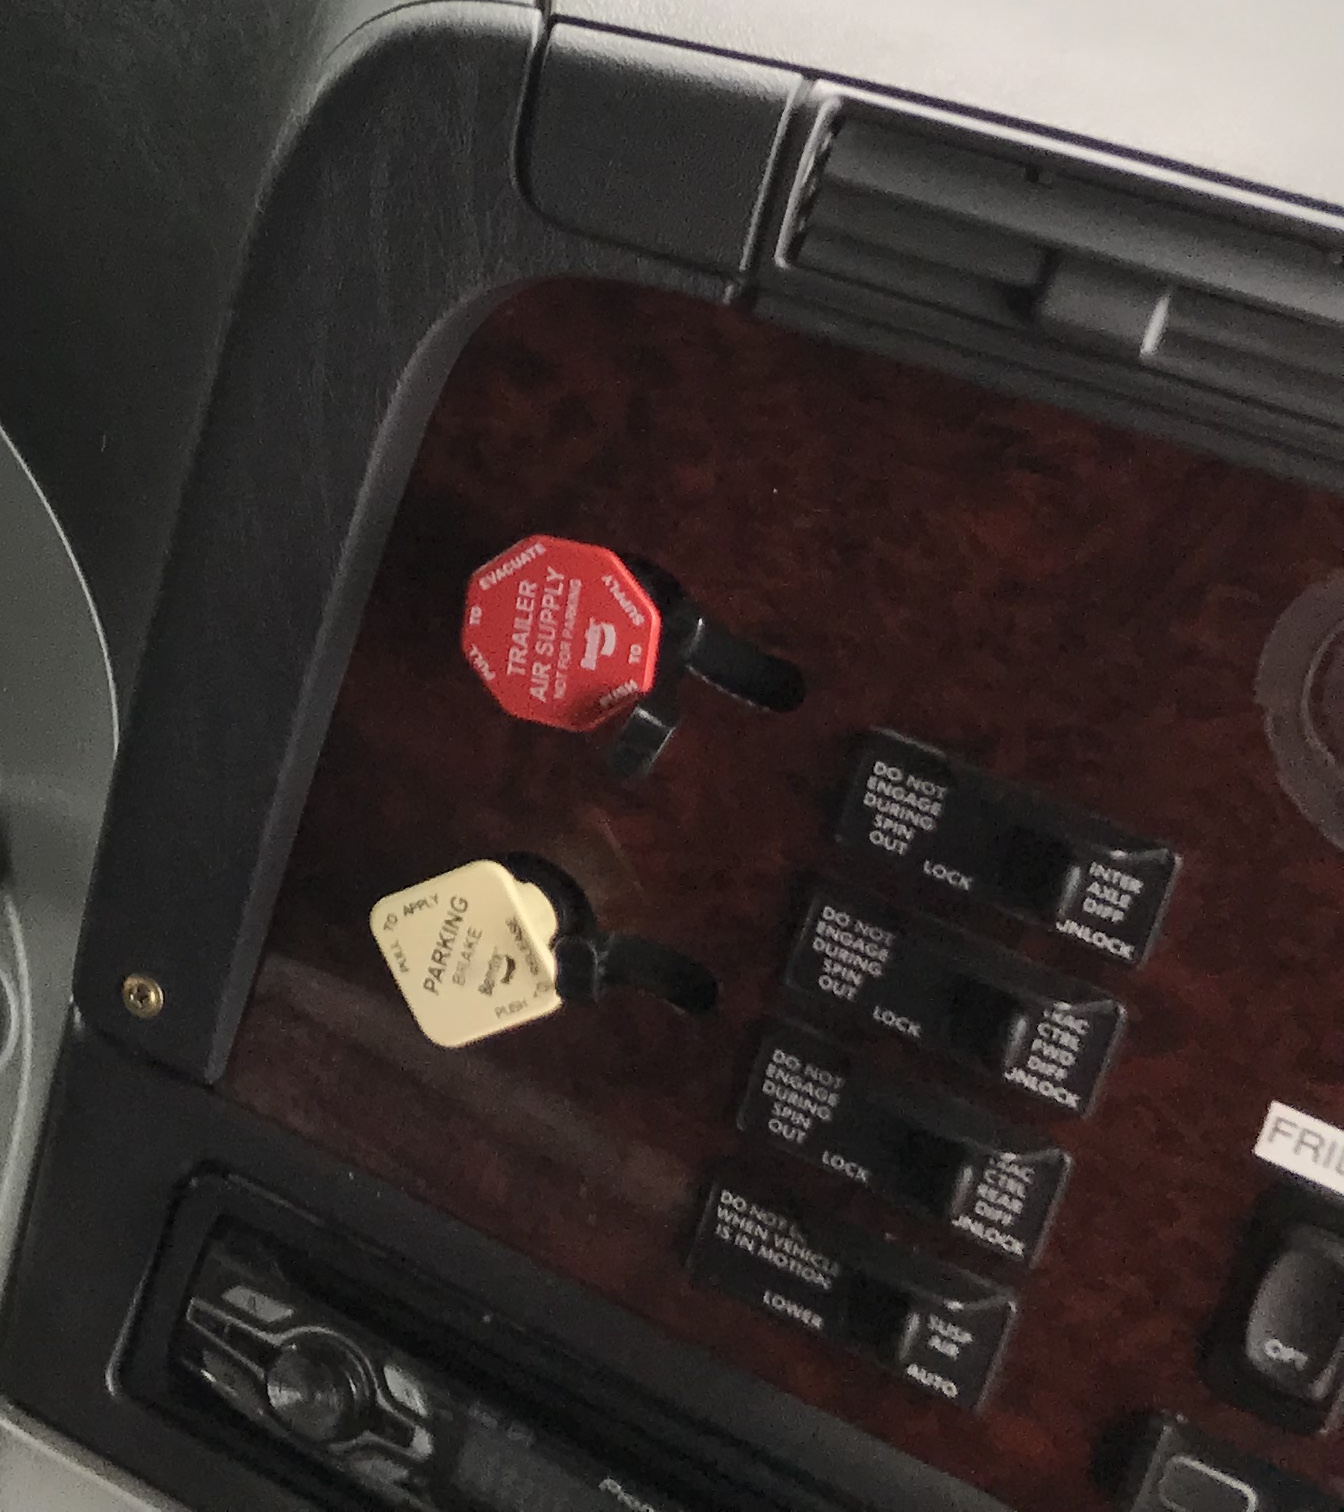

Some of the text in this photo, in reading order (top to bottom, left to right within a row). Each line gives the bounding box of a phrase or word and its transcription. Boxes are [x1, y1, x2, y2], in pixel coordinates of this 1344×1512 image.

[469, 605, 483, 625] TO
[478, 543, 547, 591] EVACUATE
[506, 579, 538, 676] TRAILER
[529, 566, 565, 703] AIR SUPPLY
[628, 643, 643, 665] TO
[867, 775, 943, 817] ENGAGE
[873, 761, 948, 800] DO NOT
[863, 791, 936, 831] DURING
[873, 814, 916, 841] SPIN
[869, 830, 908, 855] OUT
[923, 859, 973, 891] LOCK
[1089, 861, 1144, 894] INTER
[1082, 896, 1124, 923] DIFF
[1087, 881, 1132, 910] AXLE
[383, 913, 399, 932] TO
[822, 906, 895, 946] DO NOT
[422, 894, 469, 996] PARKING
[452, 926, 483, 986] BRAKE
[813, 936, 883, 977] DURING
[816, 921, 889, 962] ENGAGE
[818, 974, 857, 1001] OUT
[823, 957, 863, 986] SPIN
[872, 1006, 921, 1037] LOCK
[765, 1062, 840, 1107] ENGAGE
[772, 1048, 846, 1089] DO NOT
[762, 1079, 831, 1121] DURING
[772, 1101, 812, 1130] SPIN
[768, 1118, 806, 1143] OUT
[822, 1150, 870, 1183] LOCK
[717, 1204, 768, 1241] WHEN
[721, 1189, 787, 1229] DO NOT
[716, 1223, 731, 1240] IS
[734, 1232, 755, 1254] IN
[763, 1290, 824, 1329] LOWER
[907, 1363, 959, 1398] AUTO
